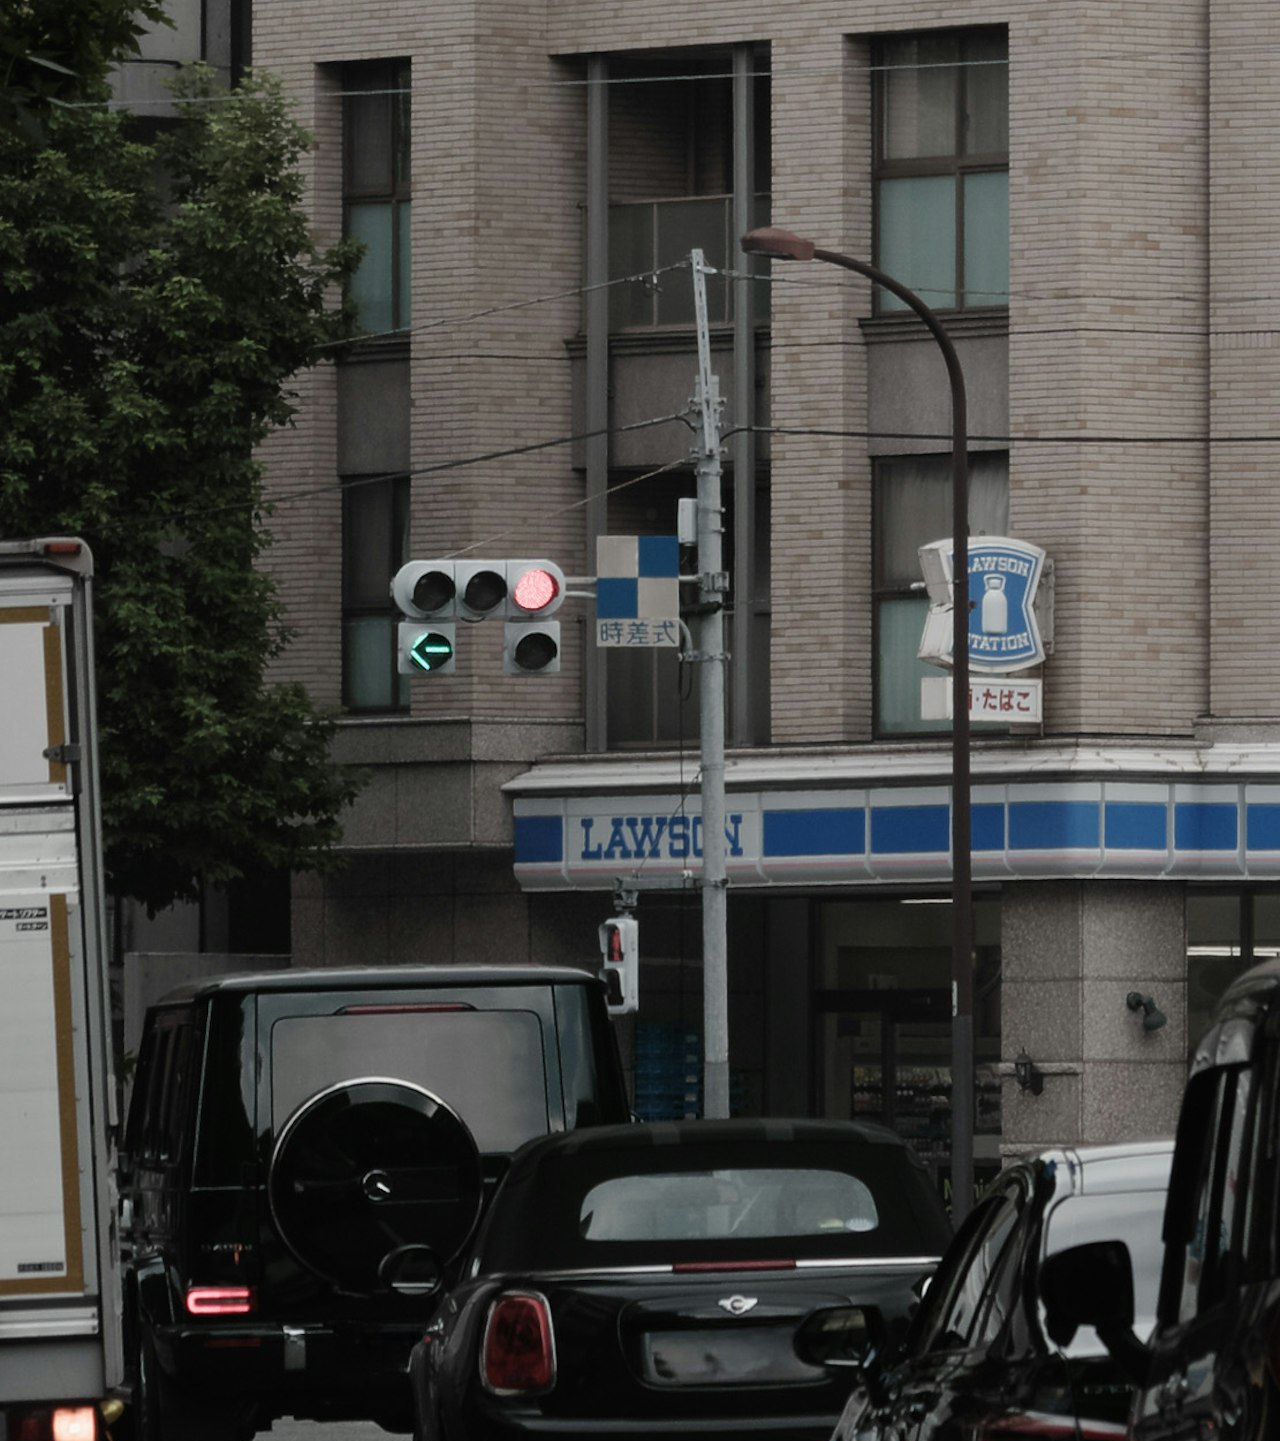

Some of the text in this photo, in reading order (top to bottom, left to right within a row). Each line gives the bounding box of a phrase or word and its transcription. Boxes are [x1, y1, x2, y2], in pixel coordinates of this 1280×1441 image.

[968, 556, 1031, 578] AWSON
[599, 620, 676, 645] 時差式
[968, 631, 1031, 652] TATION
[968, 688, 1031, 712] ・たばこ
